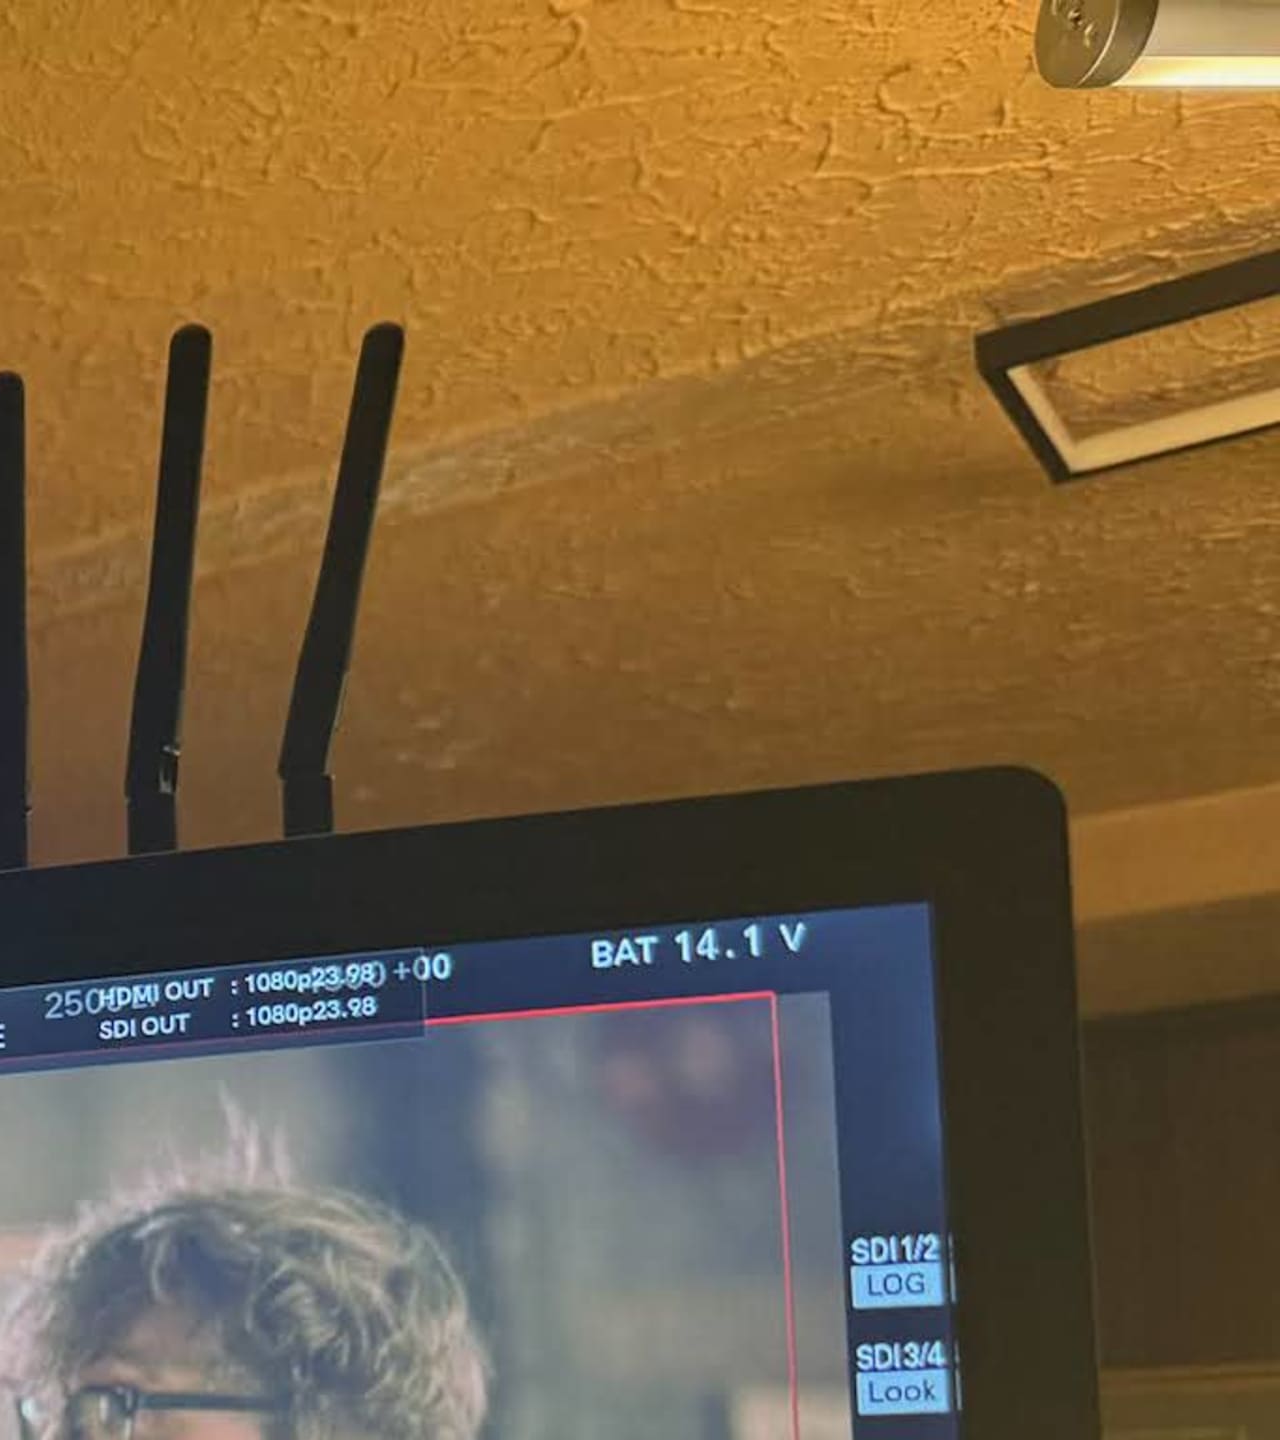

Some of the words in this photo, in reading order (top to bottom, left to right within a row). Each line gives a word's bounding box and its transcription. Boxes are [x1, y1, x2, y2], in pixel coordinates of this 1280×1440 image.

[591, 935, 658, 968] BAT
[674, 924, 762, 962] 14.1
[779, 922, 807, 952] V
[164, 977, 215, 1001] OUT
[98, 1018, 137, 1040] SDI
[141, 1013, 192, 1036] OUT
[245, 995, 378, 1026] 1080p23.98
[867, 1270, 926, 1297] LOG
[868, 1377, 937, 1404] Look
